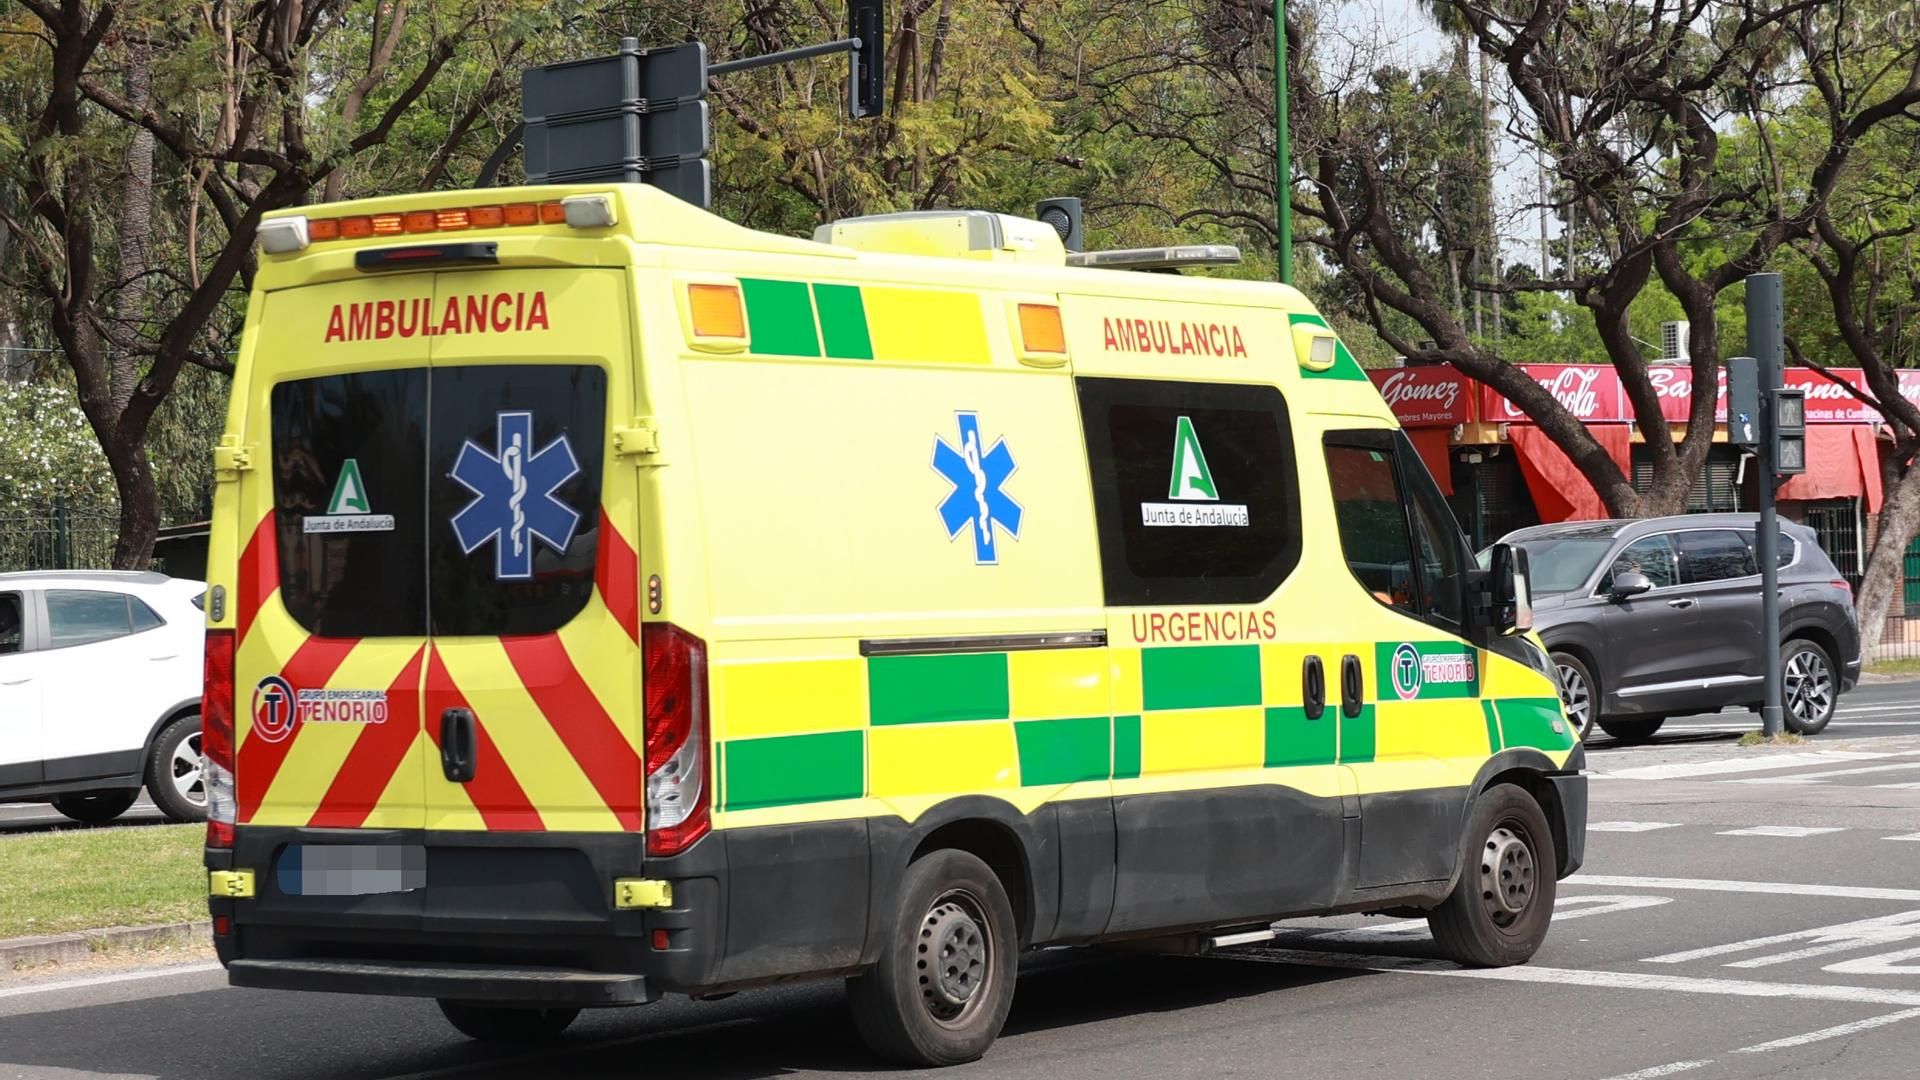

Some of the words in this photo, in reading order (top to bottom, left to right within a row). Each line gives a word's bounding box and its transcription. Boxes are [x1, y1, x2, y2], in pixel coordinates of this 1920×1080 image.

[324, 291, 550, 343] AMBULANCIA
[1103, 317, 1248, 358] AMBULANCIA
[1381, 371, 1460, 409] Gómez
[1503, 367, 1599, 416] a-Cola
[1398, 413, 1421, 422] mbres
[1422, 412, 1453, 421] Mayores
[304, 519, 331, 531] Junta
[333, 519, 345, 530] de
[1145, 507, 1176, 524] Junta
[1179, 507, 1193, 524] de
[1195, 507, 1248, 525] Andalucía
[1132, 610, 1277, 643] URGENCIAS
[1423, 663, 1474, 682] TENORIO
[299, 690, 326, 700] GRUPO
[327, 690, 386, 700] EMPRESARIAL
[299, 701, 387, 722] TENORIO
